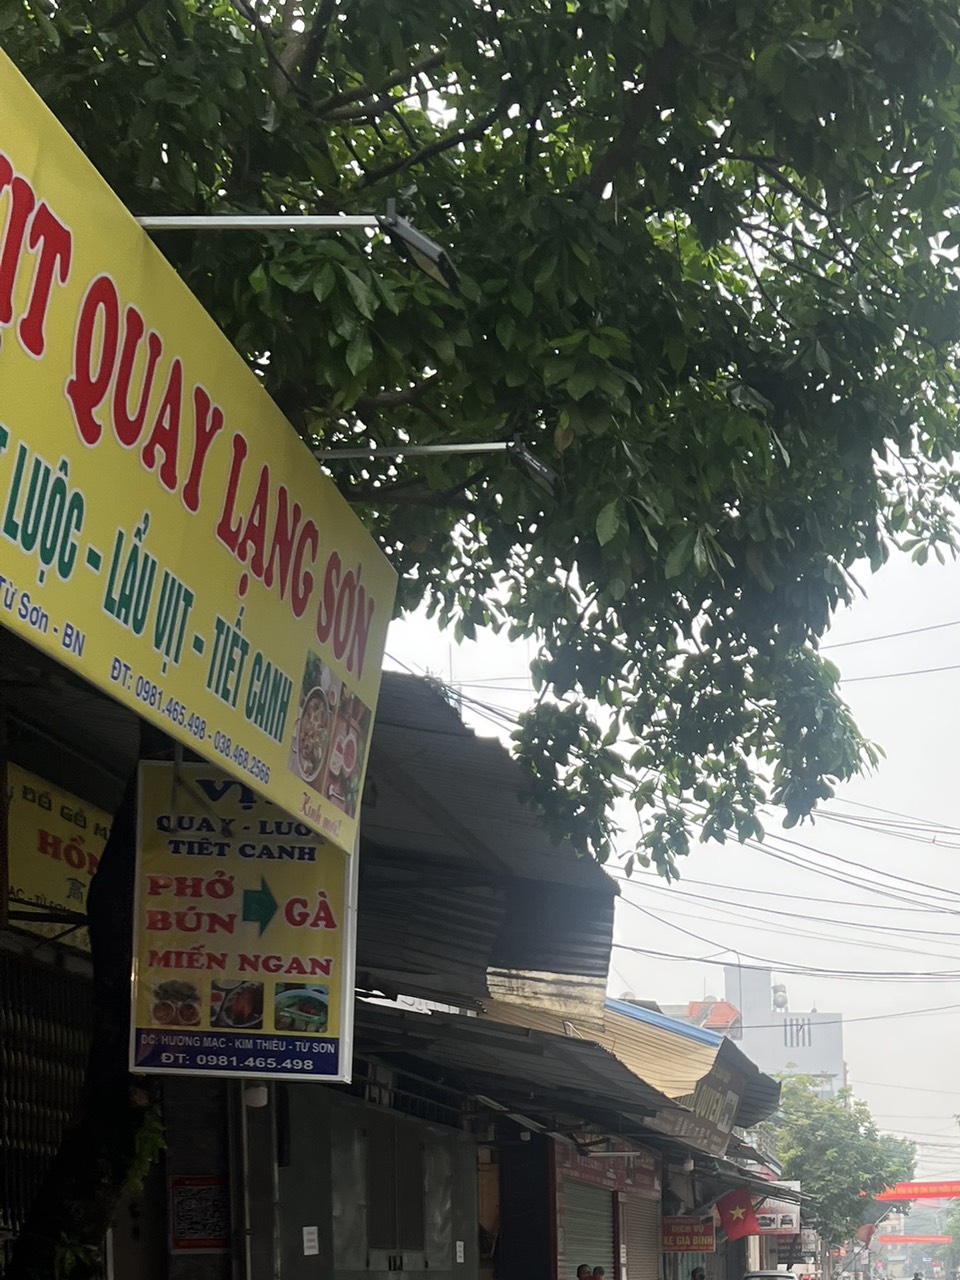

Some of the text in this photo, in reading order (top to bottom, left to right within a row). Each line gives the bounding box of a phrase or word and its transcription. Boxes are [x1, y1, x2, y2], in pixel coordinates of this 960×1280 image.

[0, 154, 374, 681] ỊT QUAY LẠNG SƠN
[3, 443, 84, 583] LUỘC
[104, 512, 157, 635] LẨU
[154, 569, 194, 674] VỊT
[206, 606, 249, 708] TIẾT
[245, 651, 293, 743] CANH
[18, 592, 49, 634] Sơn
[62, 622, 86, 657] BN
[111, 657, 133, 690] ĐT:
[136, 675, 206, 740] 0981.465.498
[214, 730, 270, 784] 038.468.2566
[195, 779, 272, 811] VỊ
[156, 815, 235, 836] QUAY
[239, 844, 316, 861] CANH
[147, 870, 235, 899] PHỞ
[146, 906, 237, 935] BÚN
[285, 891, 337, 928] GÀ
[148, 944, 333, 977] MIẾN NGAN
[161, 1034, 200, 1047] HƯƠNG
[203, 1036, 226, 1050] MẠC
[235, 1039, 253, 1049] KIM
[312, 1042, 335, 1054] SƠN
[161, 1052, 314, 1070] ĐT: 0981.465.498
